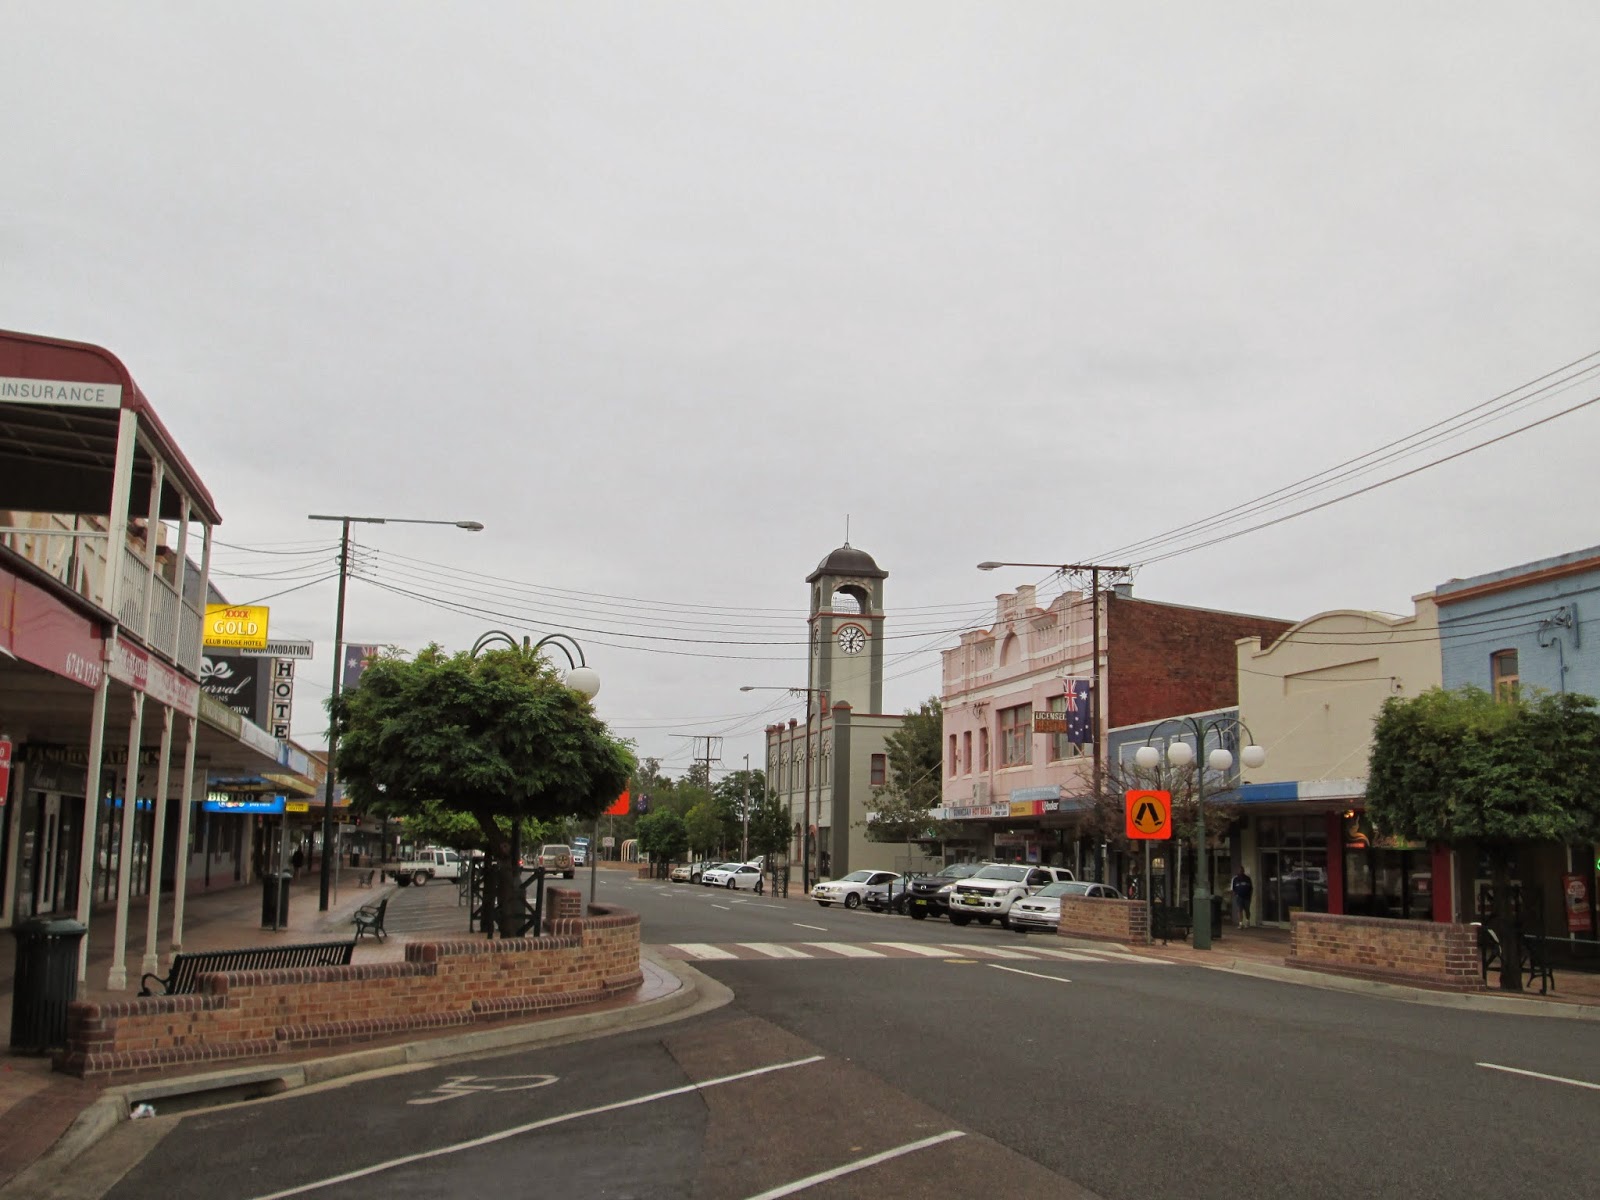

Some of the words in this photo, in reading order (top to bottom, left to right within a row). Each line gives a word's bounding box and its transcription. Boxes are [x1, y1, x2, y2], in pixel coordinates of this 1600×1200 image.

[1, 383, 105, 402] INSURANCE
[224, 609, 249, 619] XXXX
[213, 620, 258, 635] GOLD
[200, 676, 251, 695] arval
[102, 750, 161, 765] ABICS
[207, 792, 254, 802] BISTRO
